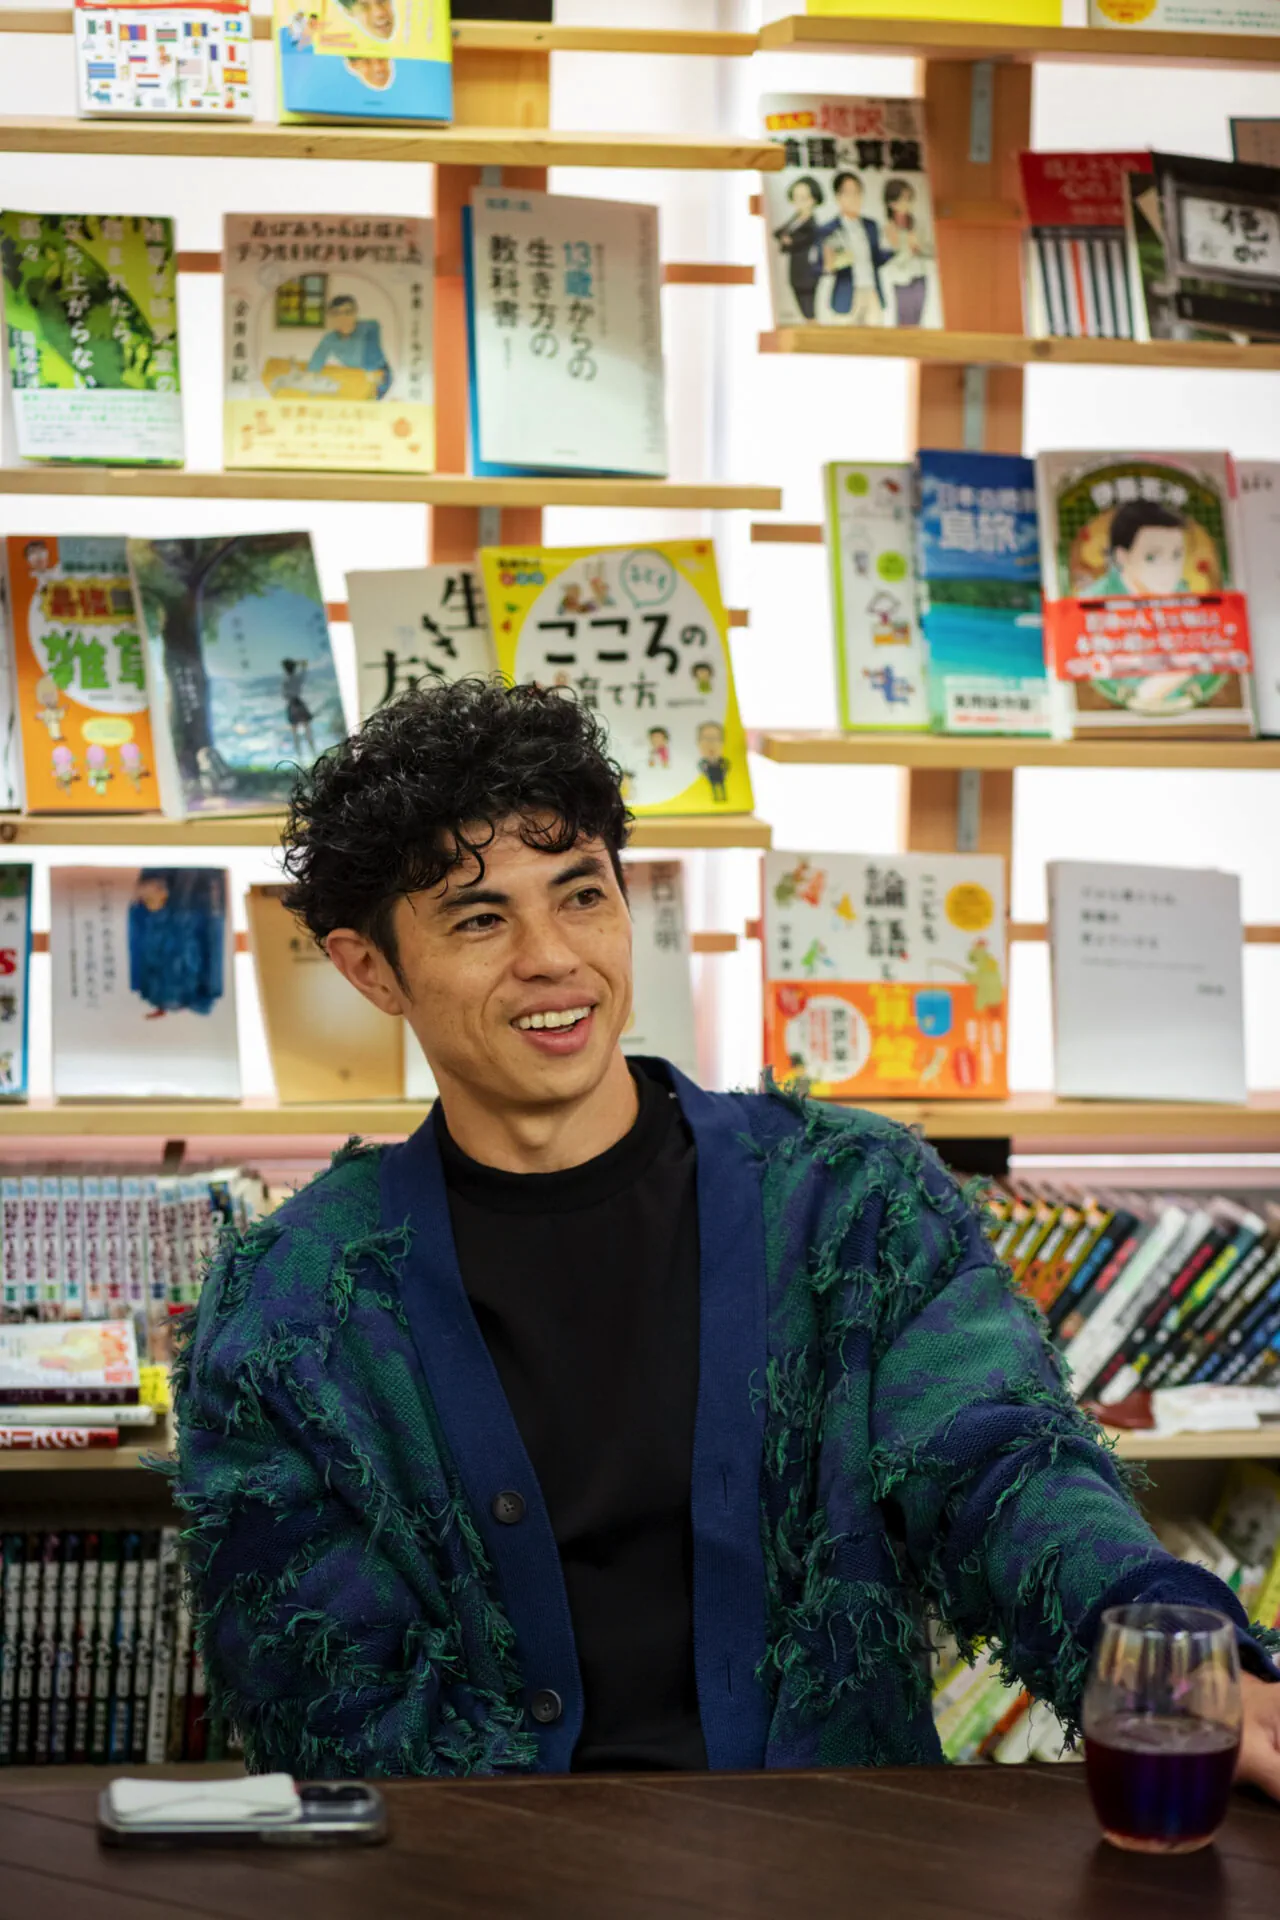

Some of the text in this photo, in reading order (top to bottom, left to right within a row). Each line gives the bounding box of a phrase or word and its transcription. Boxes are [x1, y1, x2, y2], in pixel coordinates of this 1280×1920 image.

[488, 233, 519, 329] 教科書
[526, 236, 559, 359] 生き方の
[562, 241, 598, 382] 13歳からの
[538, 612, 708, 675] こころの
[575, 669, 658, 710] 育て方
